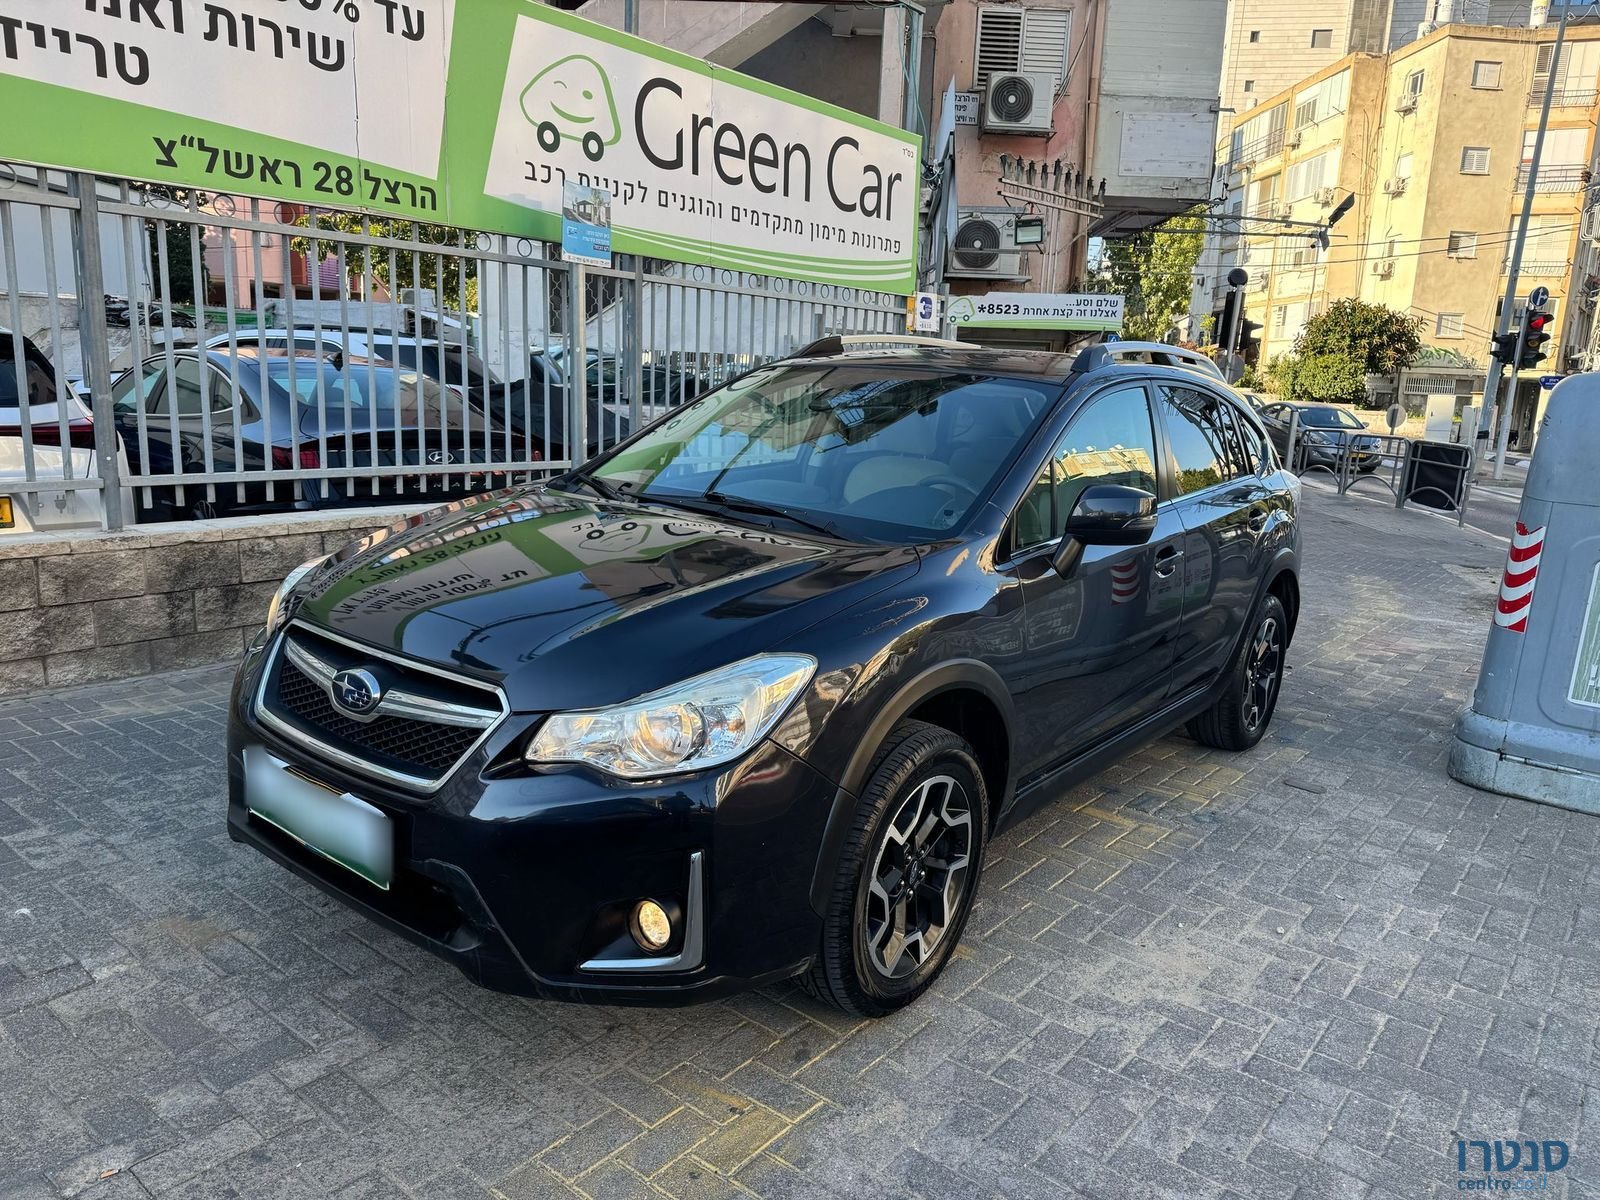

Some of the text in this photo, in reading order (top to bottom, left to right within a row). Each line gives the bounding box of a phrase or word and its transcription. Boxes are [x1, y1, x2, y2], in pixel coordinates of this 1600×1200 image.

[374, 0, 425, 42] עד
[203, 3, 345, 72] שירות
[634, 77, 903, 223] Green Car
[312, 160, 354, 196] 28
[524, 160, 566, 186] רכב
[363, 168, 437, 211] הרצל
[658, 189, 723, 219] והוגנים
[731, 205, 804, 235] מתקדמים
[810, 222, 846, 243] מימון
[851, 231, 901, 254] פתרונות
[1022, 307, 1117, 319] אצלנו זה קצת אחרת
[1096, 298, 1119, 307] שלם
